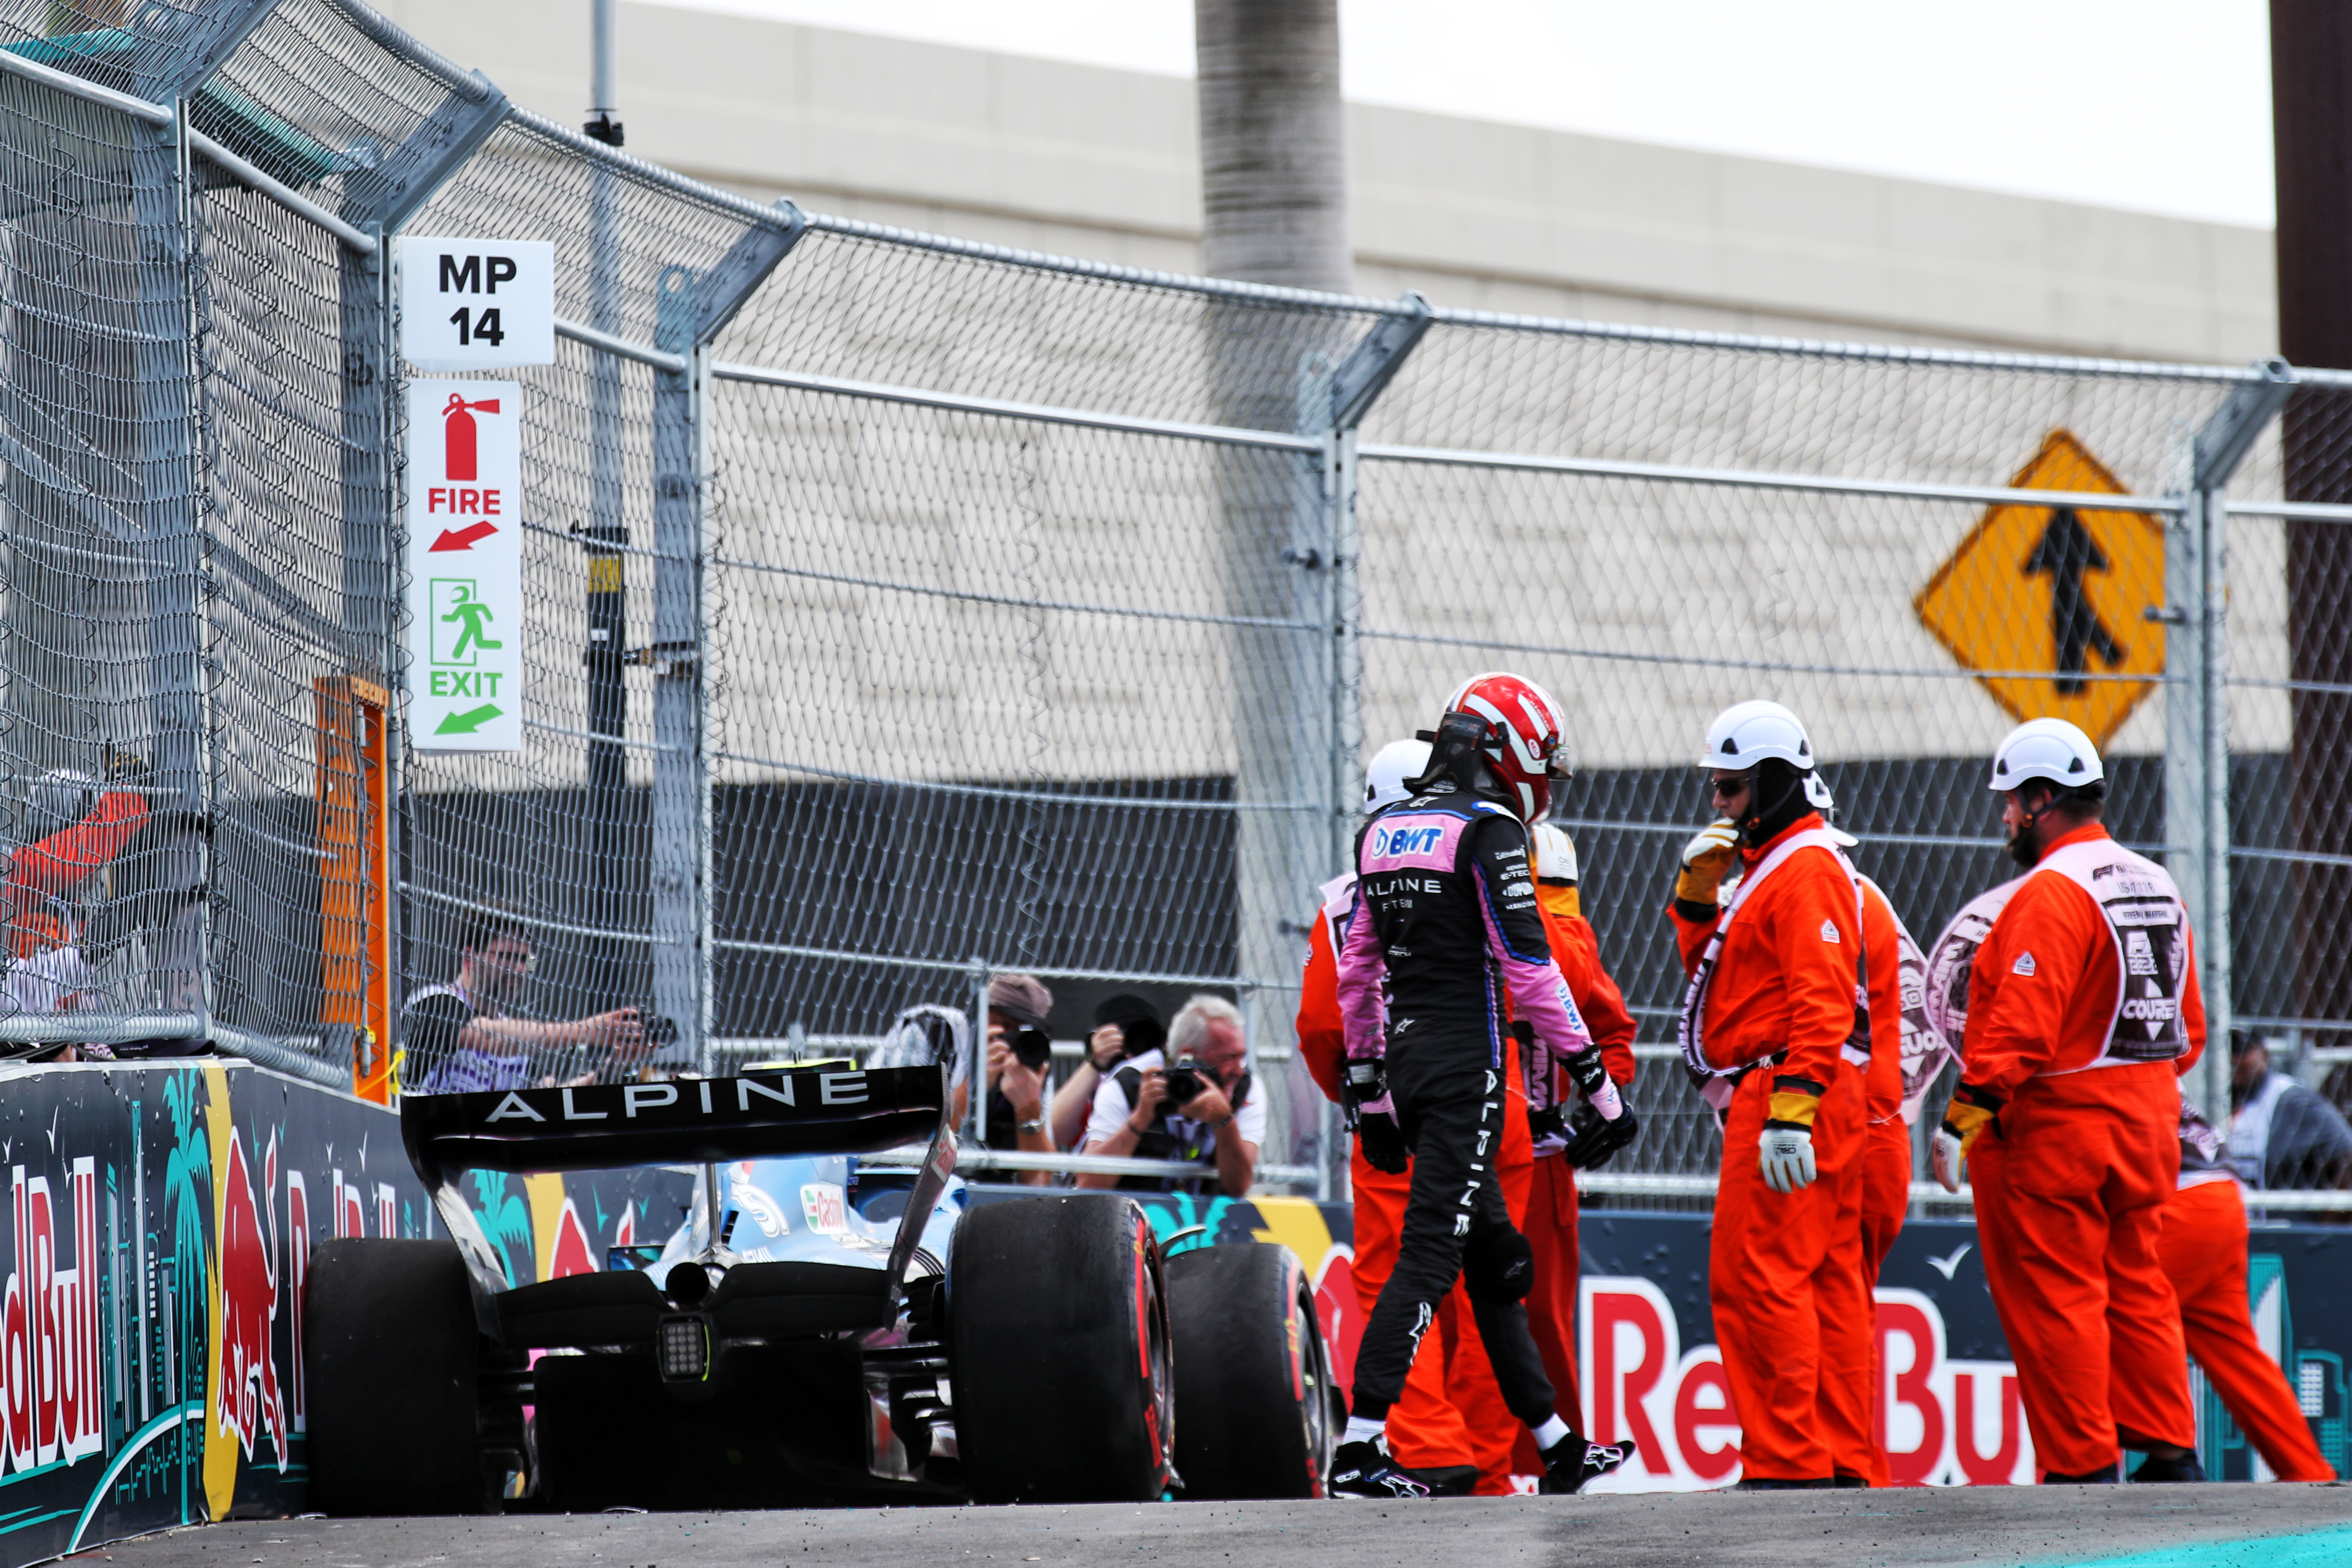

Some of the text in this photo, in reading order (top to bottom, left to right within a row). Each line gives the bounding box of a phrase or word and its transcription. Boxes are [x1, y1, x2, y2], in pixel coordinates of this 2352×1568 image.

[439, 254, 516, 294] MP
[449, 307, 504, 346] 14
[429, 488, 500, 515] FIRE
[430, 671, 502, 698] EXIT
[1388, 826, 1445, 858] BWT
[1563, 998, 1582, 1031] BWT
[485, 1071, 869, 1123] ALPINE
[29, 1158, 101, 1464] Bull
[1586, 1283, 1743, 1485] Re
